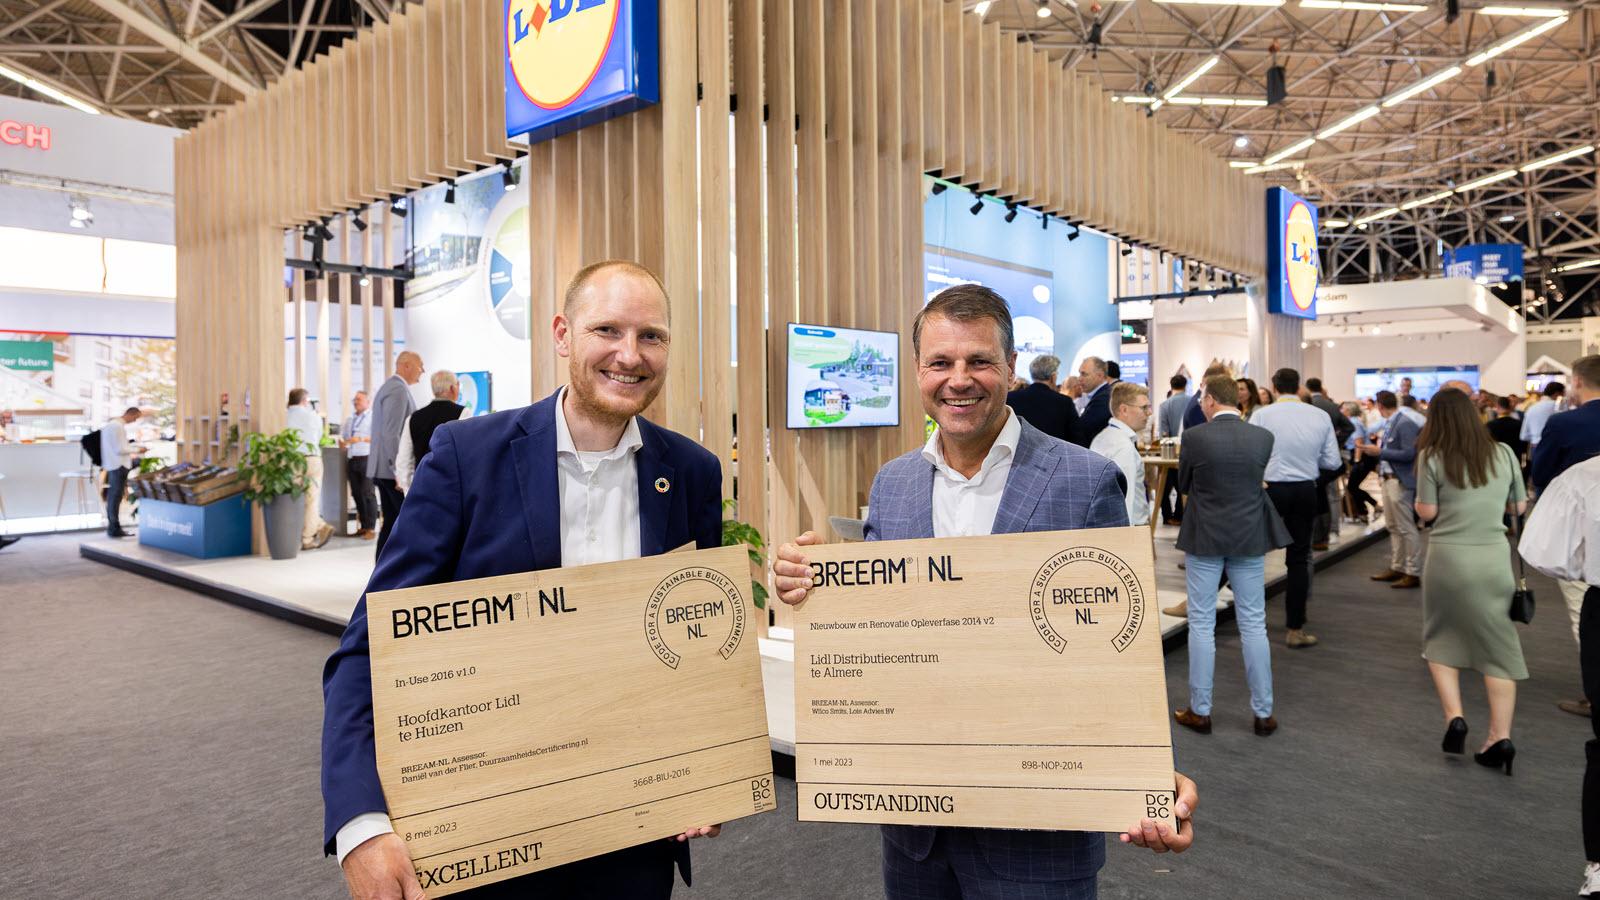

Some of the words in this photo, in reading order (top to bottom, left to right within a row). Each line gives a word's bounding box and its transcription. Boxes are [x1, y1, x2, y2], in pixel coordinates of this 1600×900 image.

[928, 555, 963, 582] NL
[1037, 551, 1095, 587] SUSTAINABLE
[1098, 553, 1125, 573] BUILT
[650, 570, 703, 609] SUSTAINABLE
[705, 571, 728, 588] BUILT
[539, 587, 577, 616] NL
[1052, 586, 1119, 605] BREEAM
[666, 600, 725, 624] BREEAM
[1033, 600, 1042, 621] FOR
[1075, 608, 1098, 625] NL
[1118, 573, 1141, 647] ENVIRONMENT
[648, 621, 657, 641] FOR
[725, 588, 743, 654] ENVIRONMENT
[810, 621, 856, 631] Nieuwbouw
[870, 619, 909, 629] Renovatie
[911, 617, 960, 629] Opleverfase
[962, 617, 981, 626] 2014
[984, 616, 994, 625] v2
[687, 623, 707, 640] NL
[1039, 623, 1061, 648] CODE
[654, 643, 675, 664] CODE
[811, 654, 831, 665] Lidl
[833, 653, 939, 665] Distributiecentrum
[395, 674, 428, 688] In-Use
[431, 670, 454, 682] 2016
[456, 666, 476, 678] v1.0
[811, 668, 821, 678] te
[823, 667, 863, 678] Almere
[398, 700, 492, 727] Hoofdkantoor
[496, 694, 521, 710] Lidl
[398, 730, 412, 742] te
[416, 722, 464, 739] Huizen
[401, 759, 450, 774] BREEAM-NL
[819, 757, 832, 766] mei
[834, 758, 853, 766] 2023
[1021, 760, 1083, 770] 898-NOP-2014
[401, 771, 427, 784] Daniël
[429, 769, 443, 778] van
[444, 766, 457, 775] der
[632, 767, 691, 789] 3668-BIU-2016
[814, 792, 954, 813] OUTSTANDING
[405, 832, 412, 841] 8
[414, 826, 432, 840] mei
[434, 822, 457, 835] 2023
